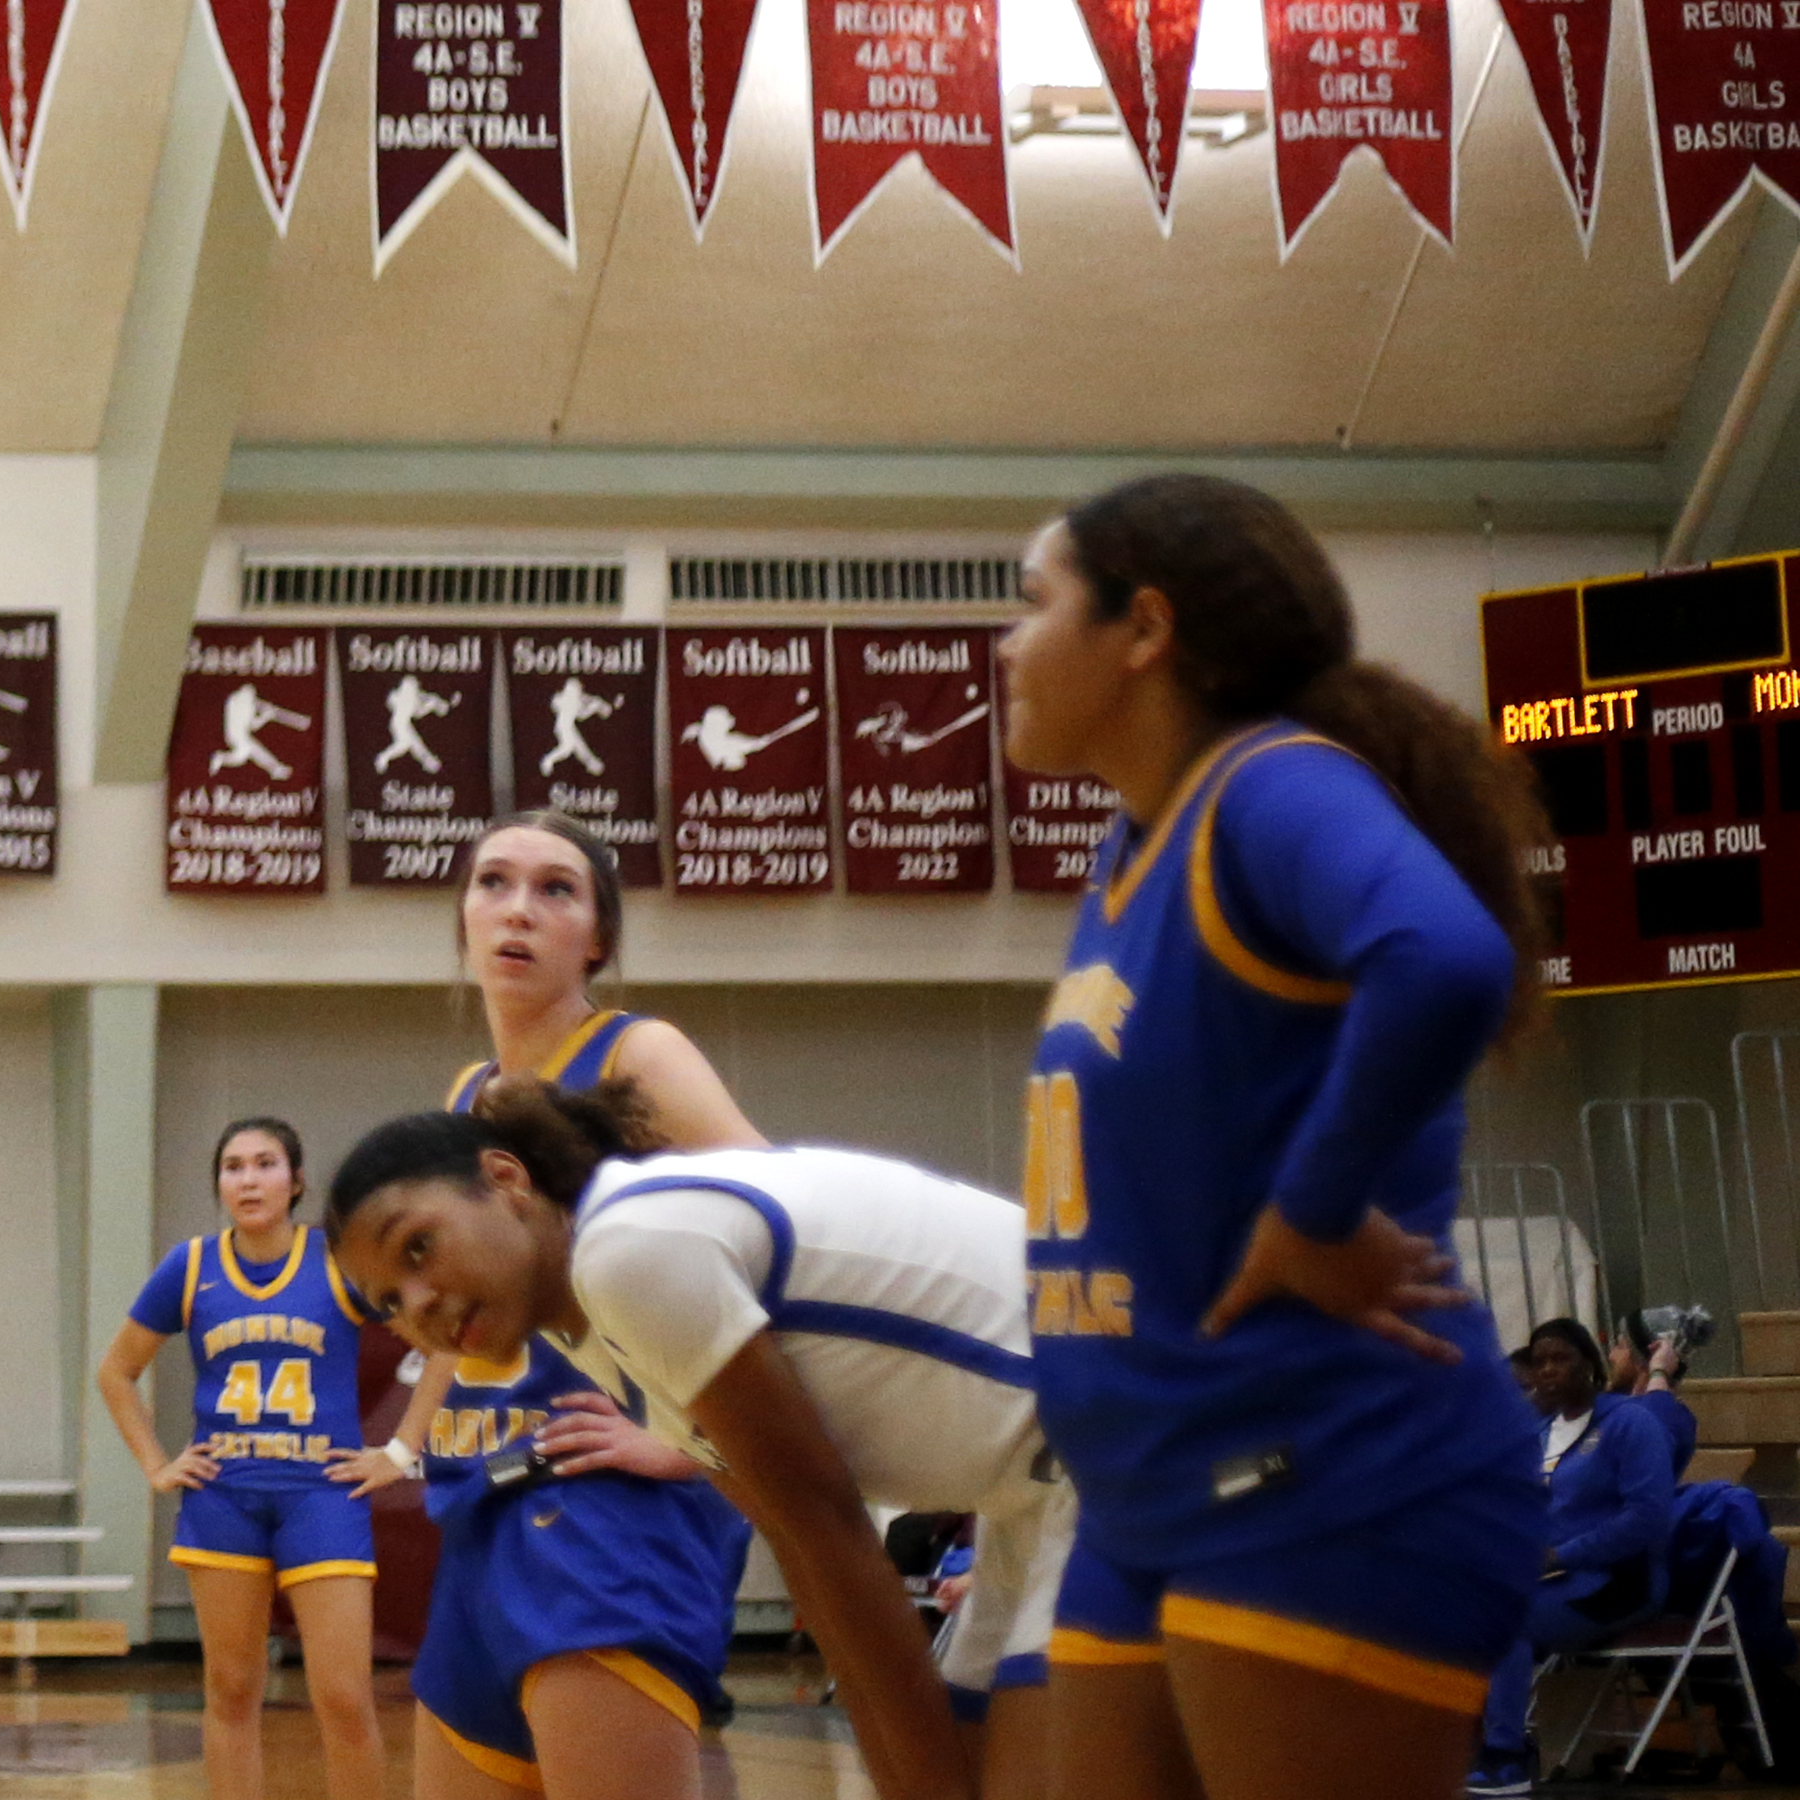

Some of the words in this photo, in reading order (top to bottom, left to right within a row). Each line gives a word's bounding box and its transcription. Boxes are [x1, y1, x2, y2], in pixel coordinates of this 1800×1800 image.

[395, 5, 505, 39] REGION
[516, 3, 540, 39] V
[835, 0, 936, 36] REGION
[1287, 0, 1386, 32] REGION
[1398, 3, 1419, 34] V
[1682, 1, 1773, 30] REGION
[1733, 42, 1756, 69] 4A
[427, 78, 509, 112] BOYS
[868, 77, 938, 108] BOYS
[1319, 73, 1394, 102] GIRLS
[1722, 80, 1786, 110] GIRLS
[377, 115, 557, 150] BASKETBALL
[822, 109, 992, 146] BASKETBALL
[1281, 107, 1443, 141] BASKETBALL
[348, 634, 482, 672] Softball
[513, 637, 644, 675] Softball
[683, 637, 812, 677] Softball
[863, 640, 971, 676] Softball
[1501, 689, 1638, 745] BARTLETT
[1652, 702, 1724, 737] PERIOD
[14, 771, 43, 800] V
[381, 781, 455, 812] State
[548, 782, 619, 812] State
[848, 786, 882, 811] 4A
[889, 783, 975, 817] Region
[213, 786, 302, 822] Region
[683, 789, 720, 818] 4A
[721, 787, 804, 821] Region
[169, 819, 322, 854] Champions
[676, 821, 827, 854] Champions
[1632, 830, 1704, 865] PLAYER
[1714, 825, 1766, 855] FOUL
[170, 851, 320, 885] 2018-2019
[384, 845, 454, 879] 2007
[678, 852, 829, 886] 2018-2019
[899, 851, 959, 880] 2022
[1668, 943, 1736, 974] MATCH
[215, 1359, 316, 1425] 44
